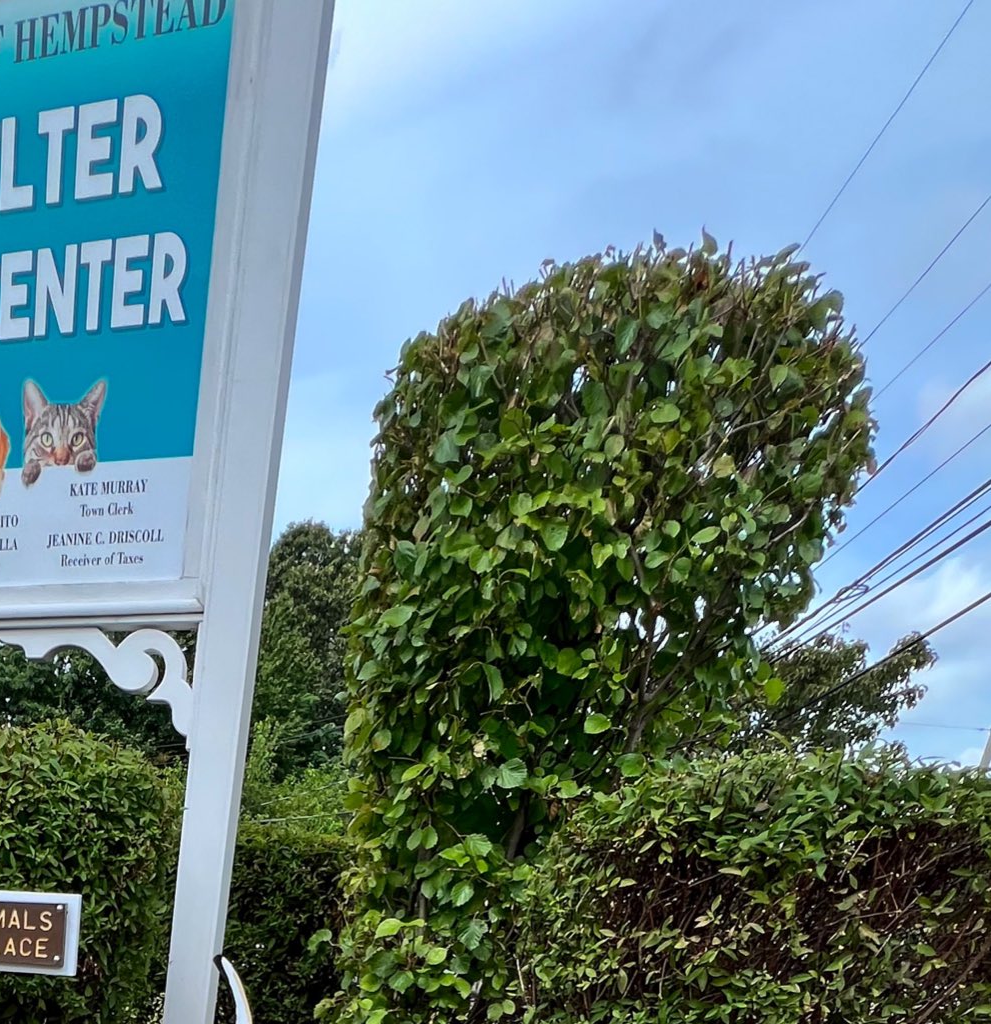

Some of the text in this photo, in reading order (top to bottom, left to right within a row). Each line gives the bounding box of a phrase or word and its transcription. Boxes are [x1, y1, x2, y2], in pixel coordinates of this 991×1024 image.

[13, 0, 227, 64] HEMPSTEAD
[69, 478, 149, 497] KATE MURRAY
[80, 501, 134, 518] Town Clerk
[46, 528, 164, 549] JEANINE C. DRISCOLL
[60, 551, 144, 568] Receiver of Taxes
